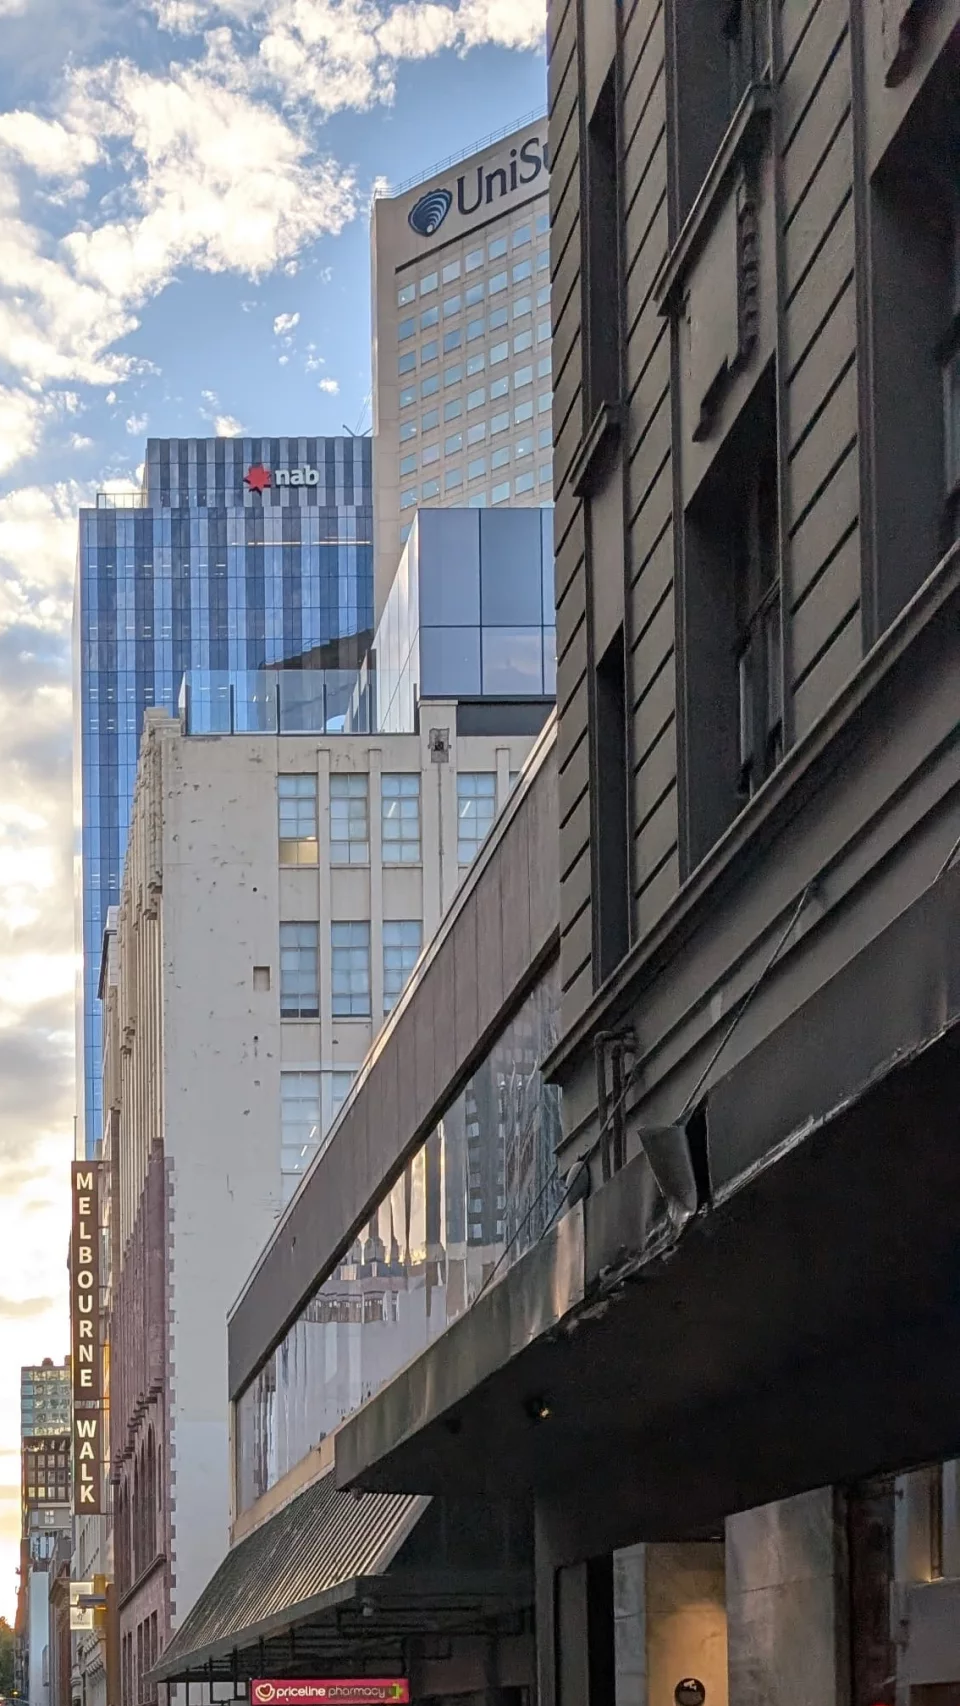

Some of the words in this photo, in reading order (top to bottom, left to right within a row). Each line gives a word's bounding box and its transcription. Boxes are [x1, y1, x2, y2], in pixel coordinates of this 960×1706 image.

[274, 464, 320, 486] nab
[75, 1171, 94, 1388] MELBOURNE
[76, 1419, 97, 1503] WALK
[276, 1685, 326, 1699] priceline
[327, 1686, 386, 1699] pharmacy
